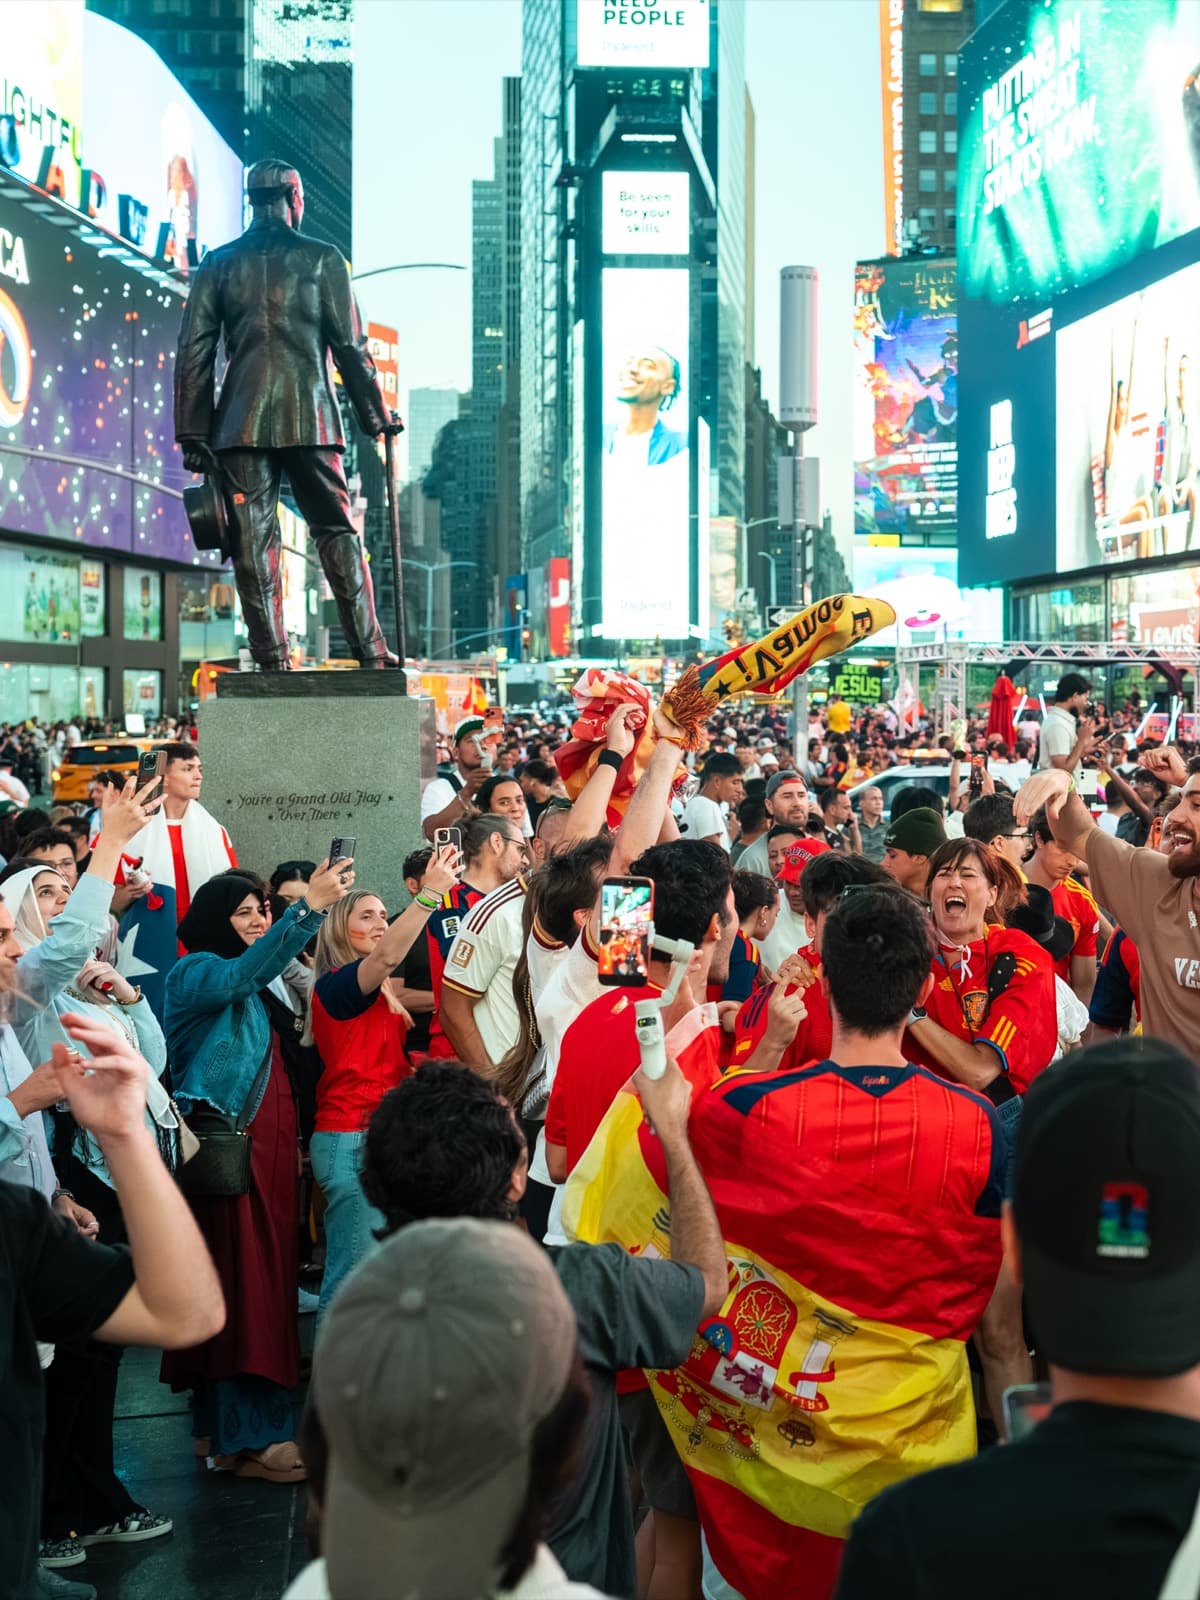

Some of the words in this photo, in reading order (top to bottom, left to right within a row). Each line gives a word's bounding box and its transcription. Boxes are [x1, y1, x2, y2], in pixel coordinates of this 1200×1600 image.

[603, 10, 686, 26] PEOPLE
[829, 675, 882, 697] JESUS
[238, 793, 273, 808] You're
[275, 797, 285, 805] a
[288, 792, 326, 808] Grand
[330, 791, 351, 805] Old
[353, 790, 384, 808] Flag
[309, 807, 341, 821] There
